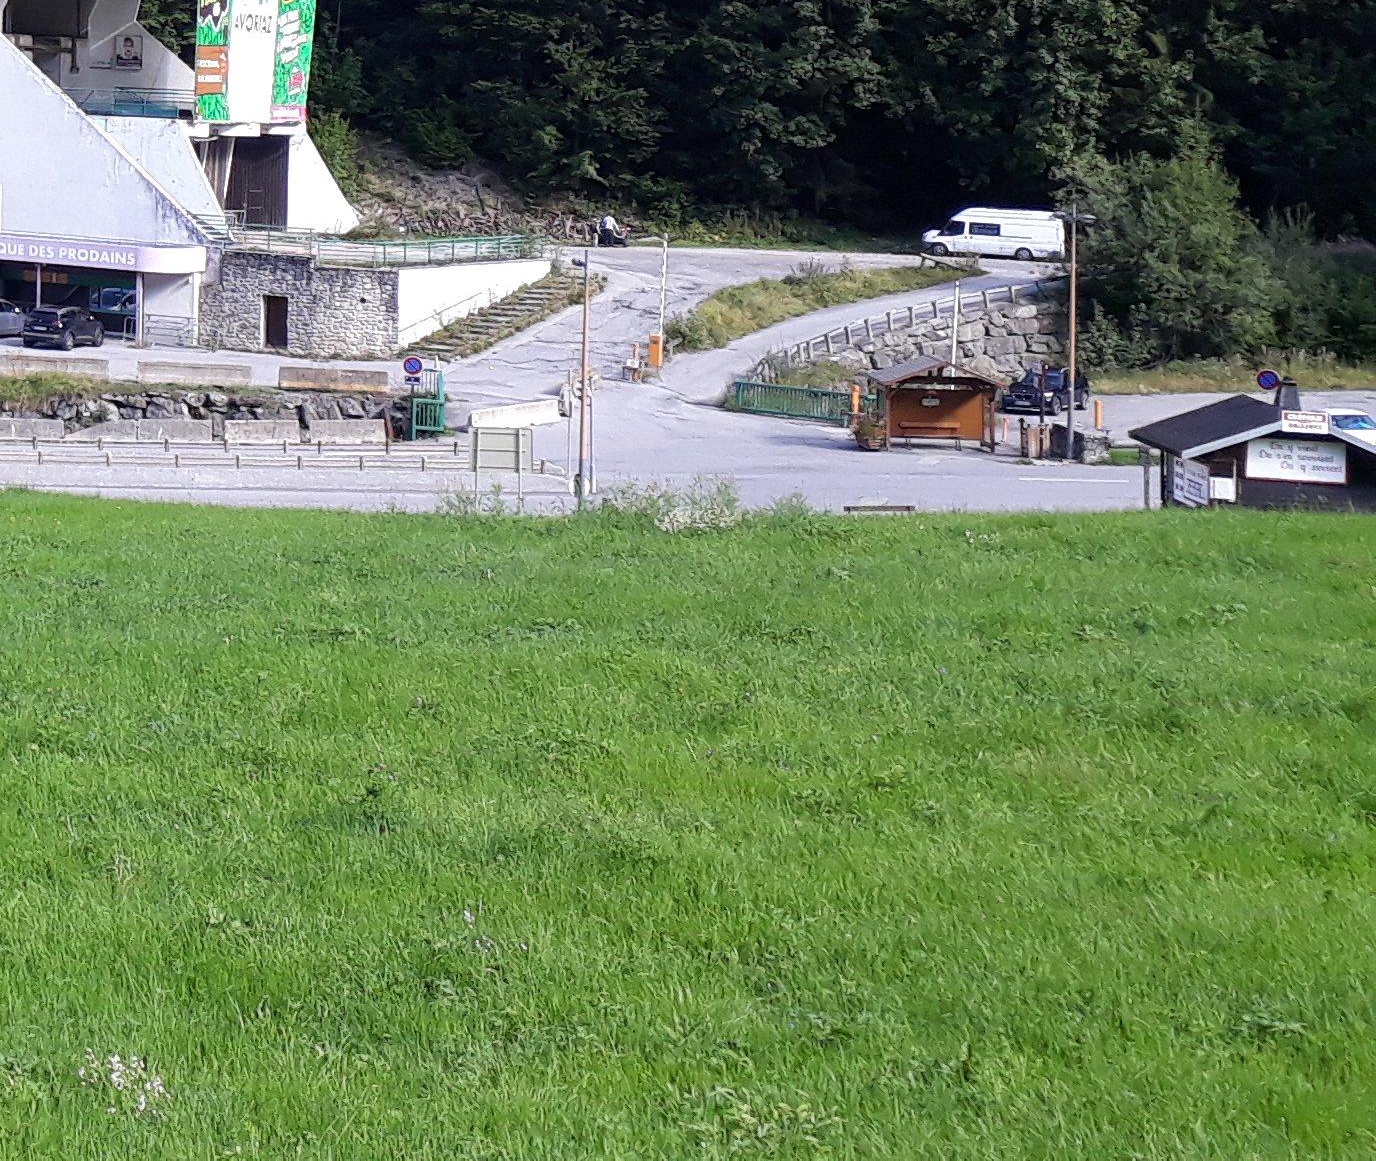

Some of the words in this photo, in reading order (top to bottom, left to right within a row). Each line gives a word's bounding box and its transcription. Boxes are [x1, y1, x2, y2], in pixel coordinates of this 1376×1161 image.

[234, 13, 273, 34] AVORIAZ
[28, 244, 55, 259] DES
[59, 248, 136, 267] PRODAINS
